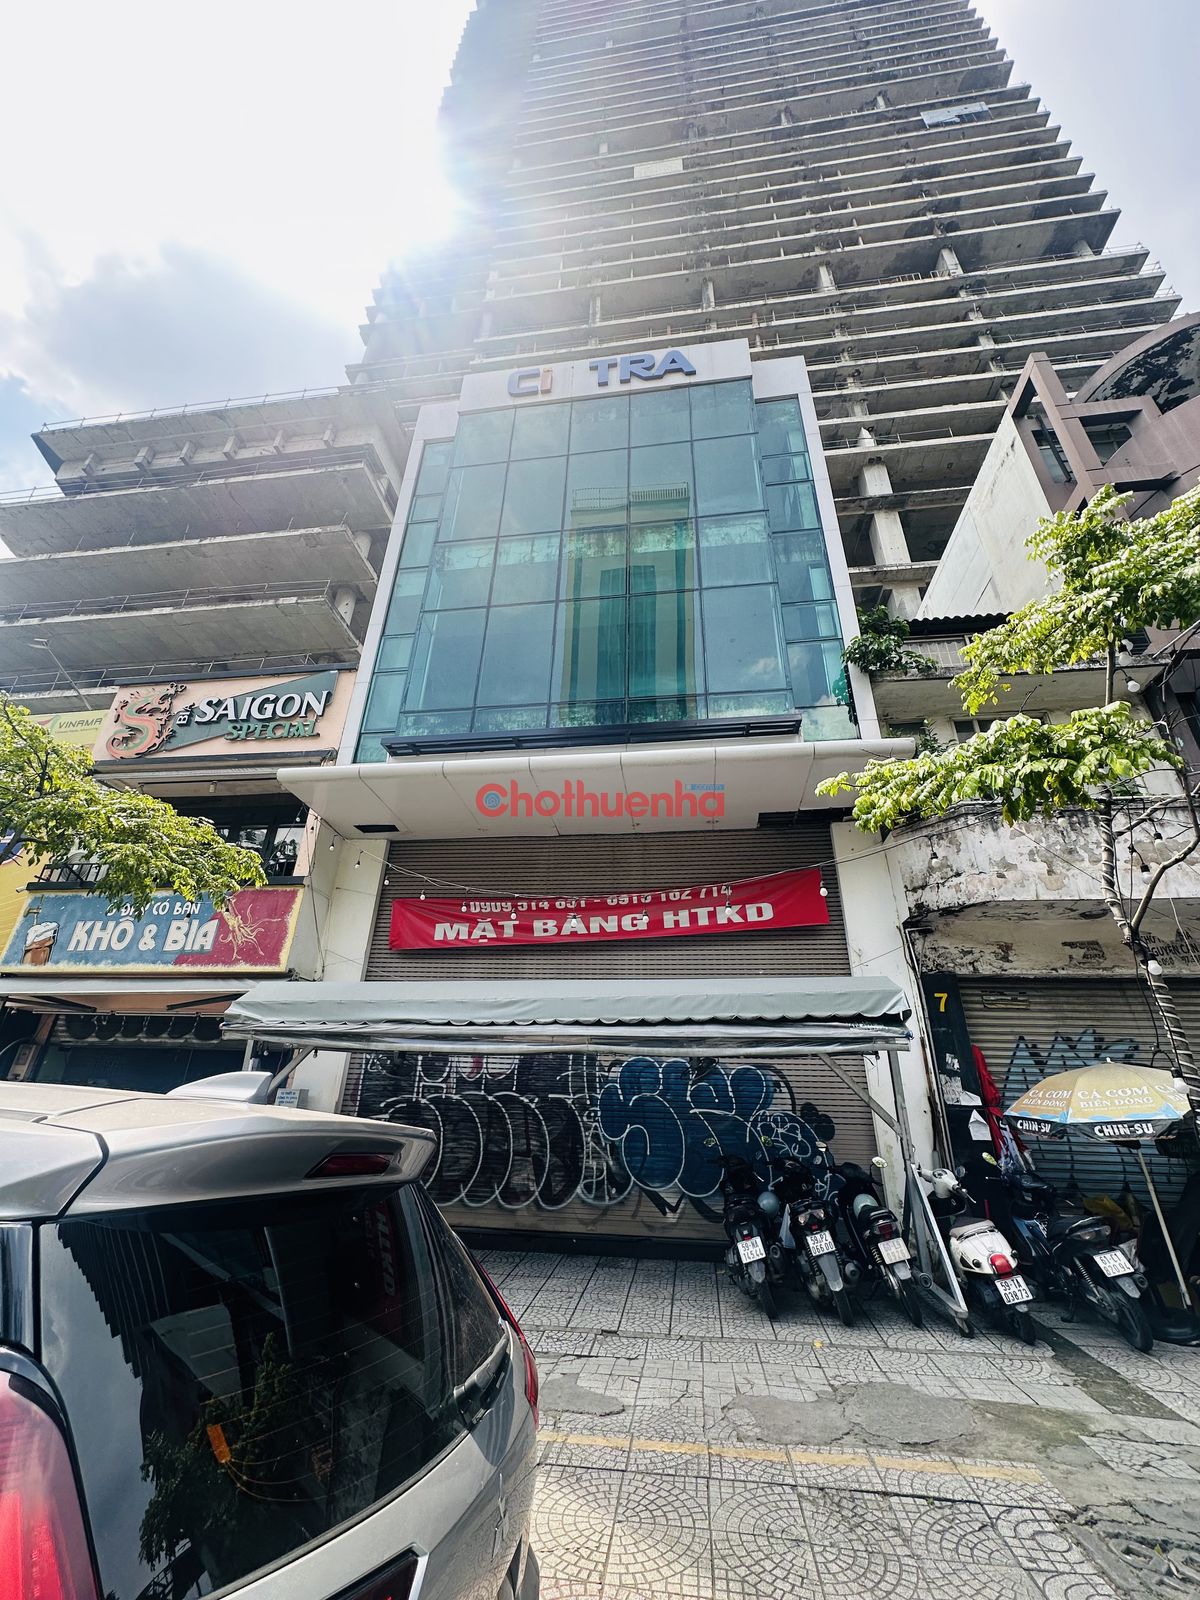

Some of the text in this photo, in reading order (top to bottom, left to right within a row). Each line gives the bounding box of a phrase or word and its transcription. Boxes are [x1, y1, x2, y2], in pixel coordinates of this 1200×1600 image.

[589, 350, 696, 387] TRA
[176, 702, 195, 726] BIA
[195, 690, 331, 724] SAIGON
[224, 720, 320, 741] SPECIAL
[67, 916, 219, 951] KHÔ & BIA
[434, 918, 520, 943] MẶT
[663, 902, 774, 929] HTKD
[934, 992, 948, 1013] 7
[1094, 1122, 1154, 1137] CHIN-SU
